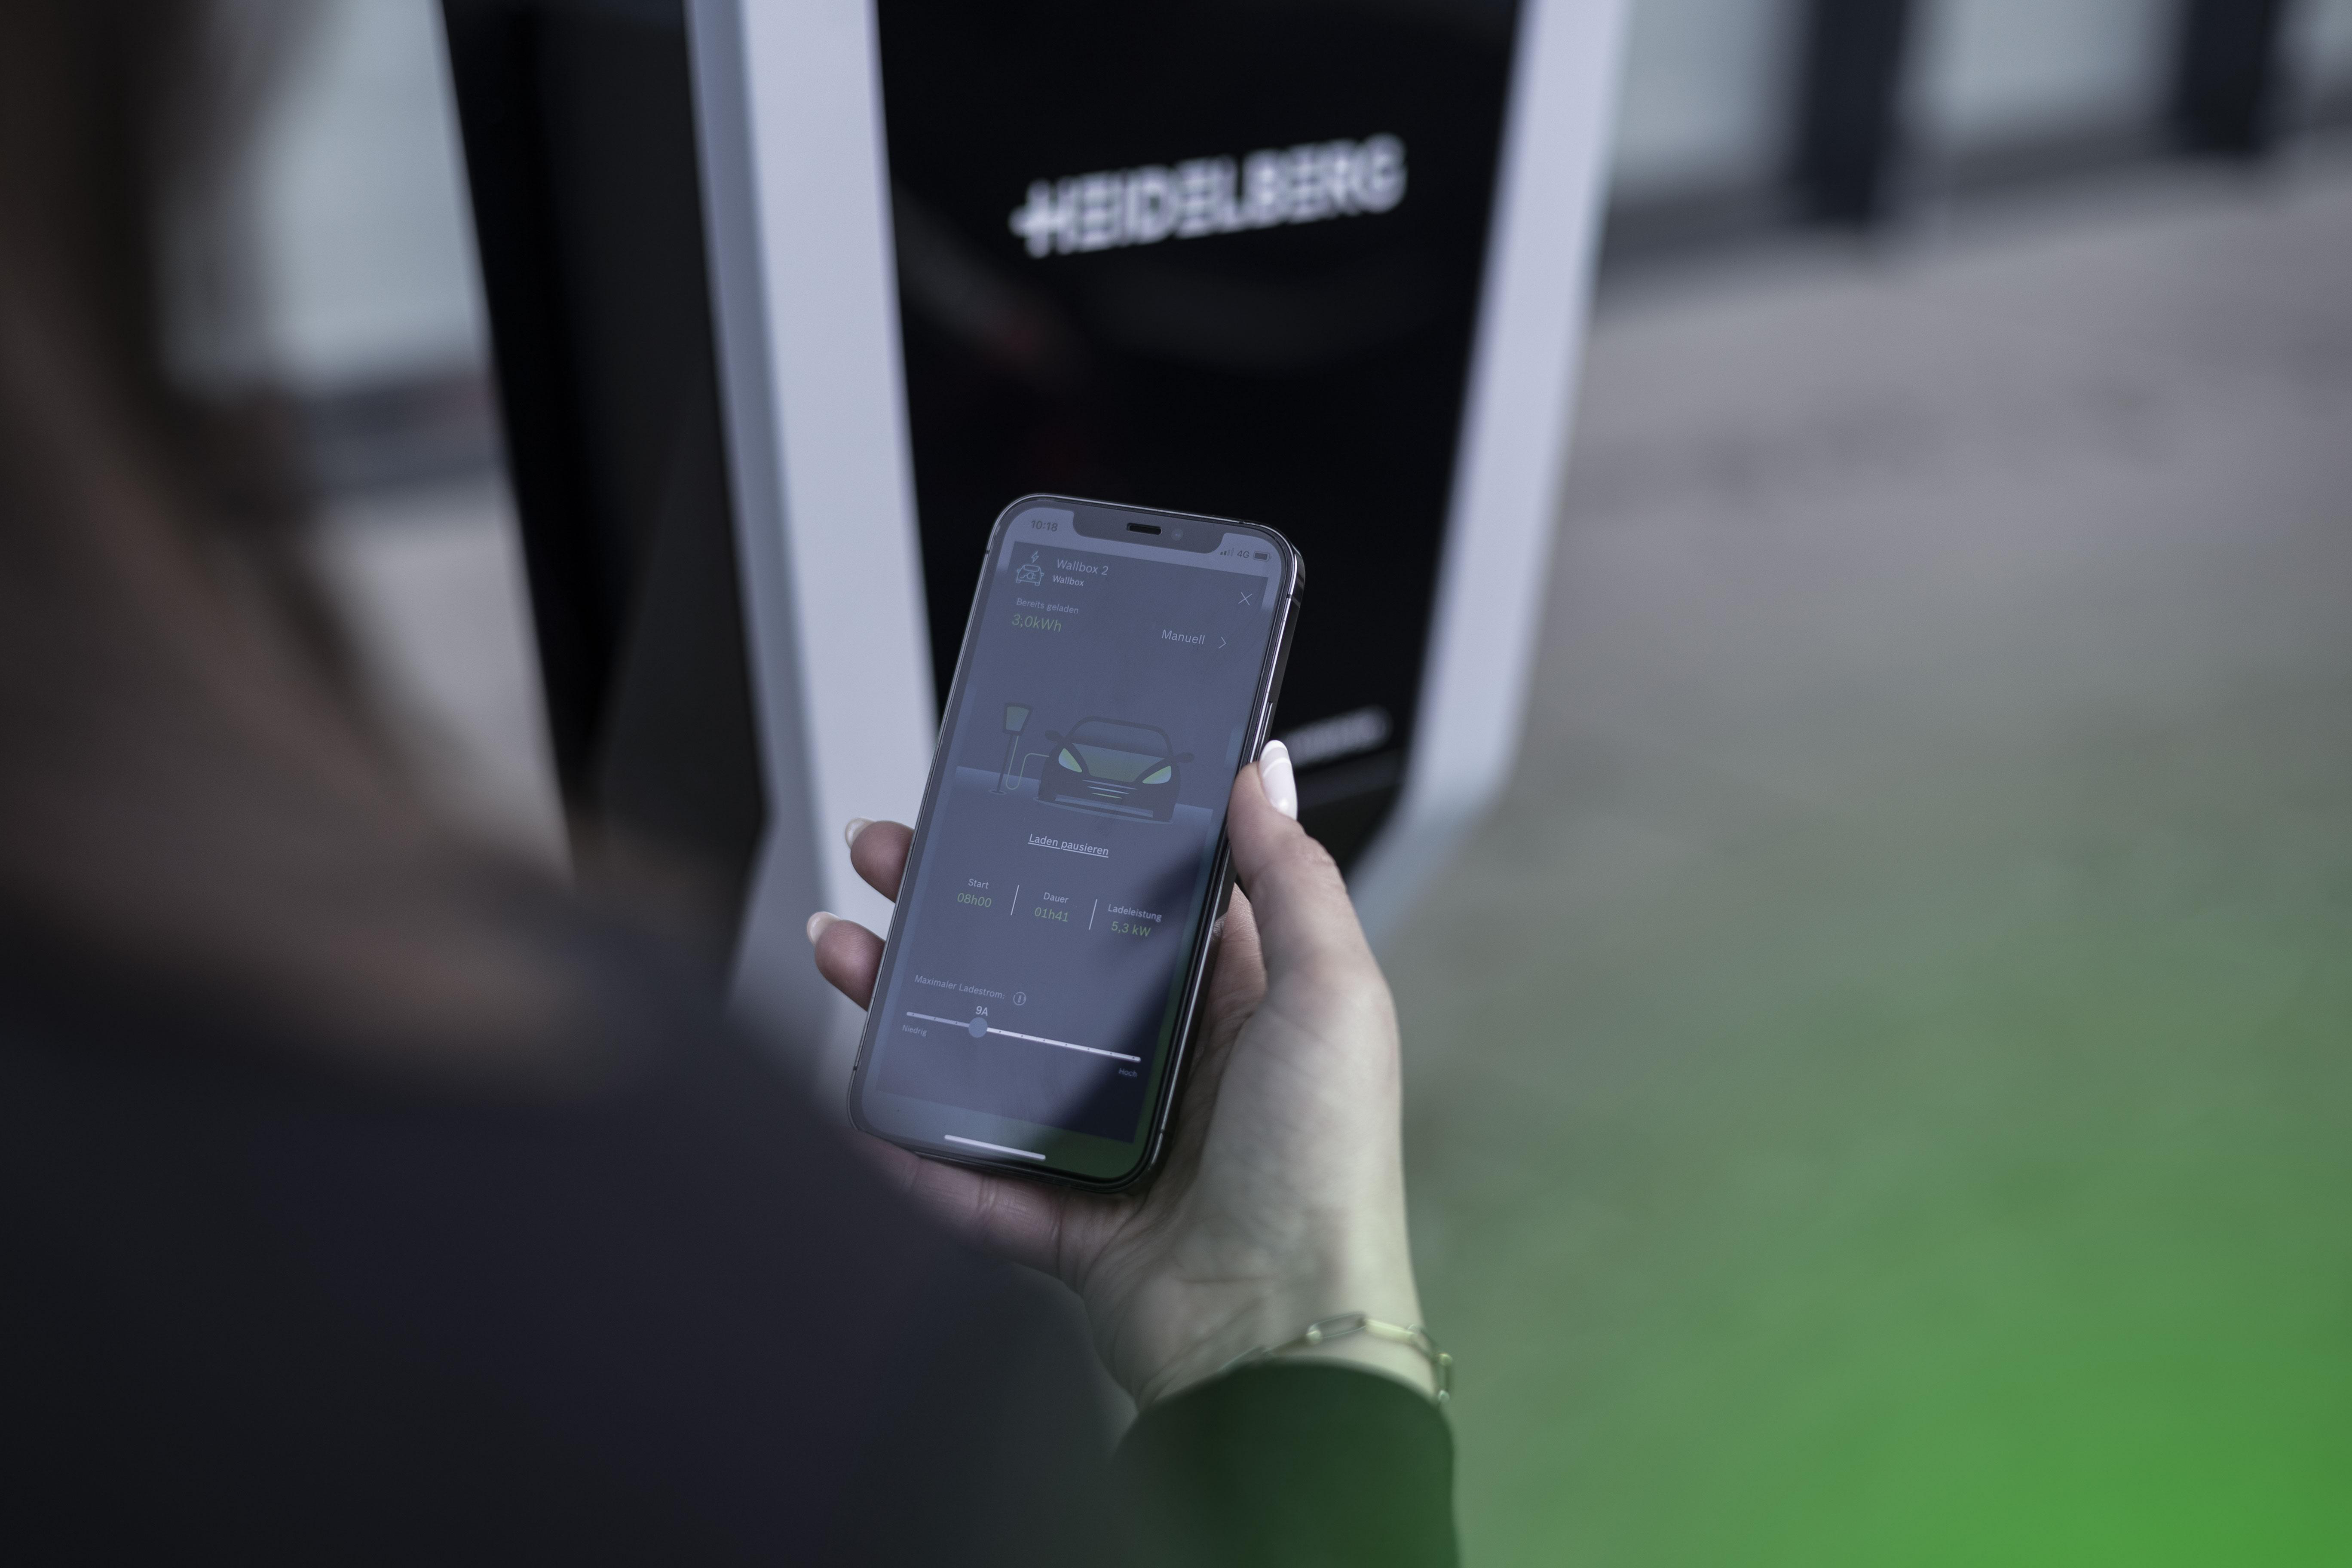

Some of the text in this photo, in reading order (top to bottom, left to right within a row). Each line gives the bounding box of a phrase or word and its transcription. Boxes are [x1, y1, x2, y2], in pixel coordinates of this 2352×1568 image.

[1010, 132, 1406, 258] HEIDELBERG
[1031, 520, 1058, 533] 10:18
[1237, 550, 1250, 559] 4G
[1057, 559, 1109, 576] Wallbox 2
[1052, 575, 1084, 587] Wallbox
[1016, 597, 1079, 616] Bereits geladen
[1161, 629, 1205, 645] Manuell
[1029, 833, 1109, 857] Laden pausieren
[968, 878, 989, 889] Start
[957, 892, 992, 908] 08h00
[1043, 892, 1069, 903] Dauer
[1035, 906, 1069, 922] 01h41
[1108, 903, 1162, 922] Ladeleistung
[1111, 921, 1151, 937] 5,3 kW
[915, 974, 1006, 999] Maximaler Ladestrom:
[975, 1006, 989, 1016] 9A
[902, 1025, 927, 1036] Niedrig
[1119, 1068, 1137, 1077] Hoch
